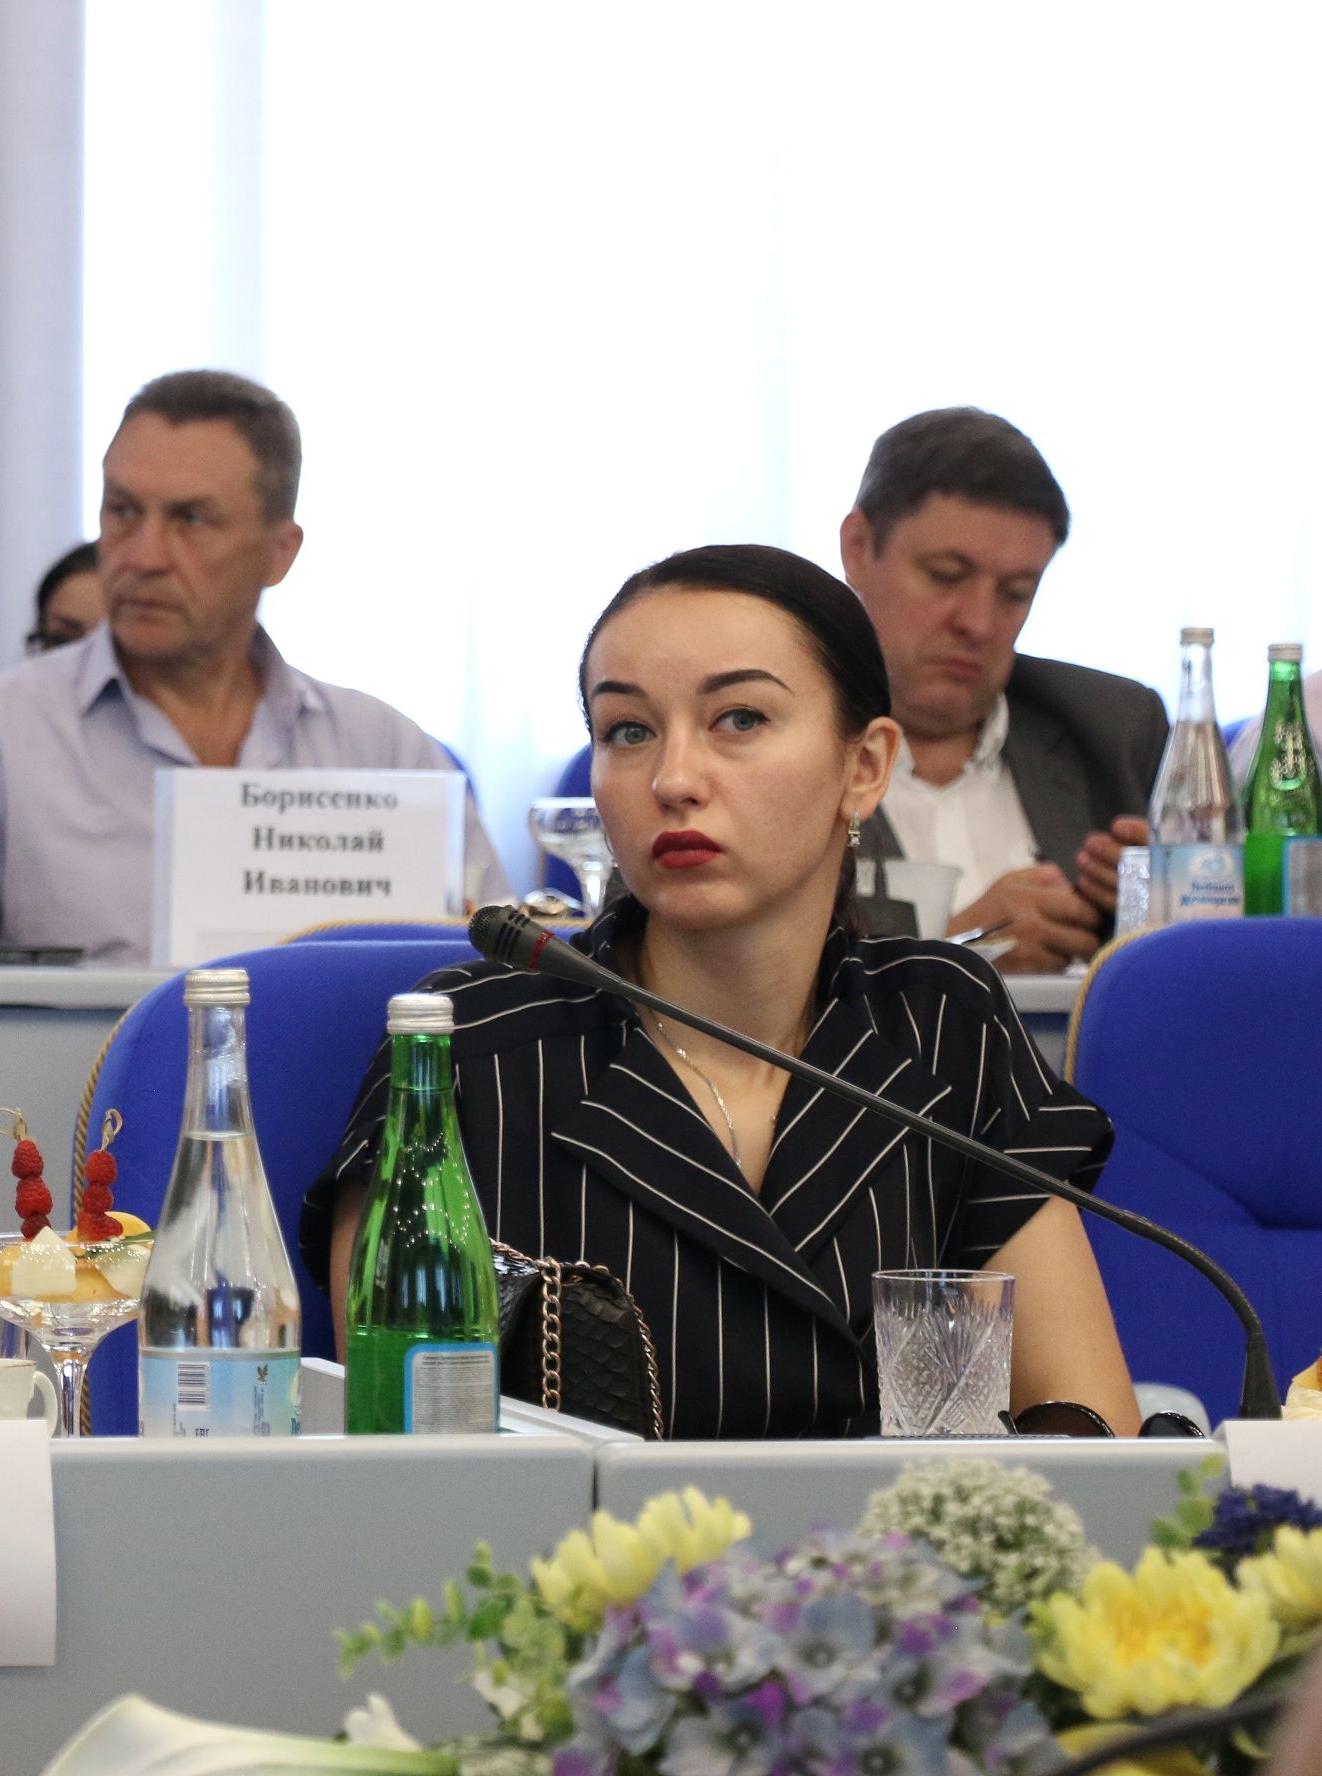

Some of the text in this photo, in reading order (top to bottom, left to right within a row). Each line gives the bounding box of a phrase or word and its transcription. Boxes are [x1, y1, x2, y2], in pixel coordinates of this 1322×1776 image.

[240, 782, 399, 814] Борисенко
[251, 826, 384, 852] Николай
[243, 868, 391, 897] Иванович
